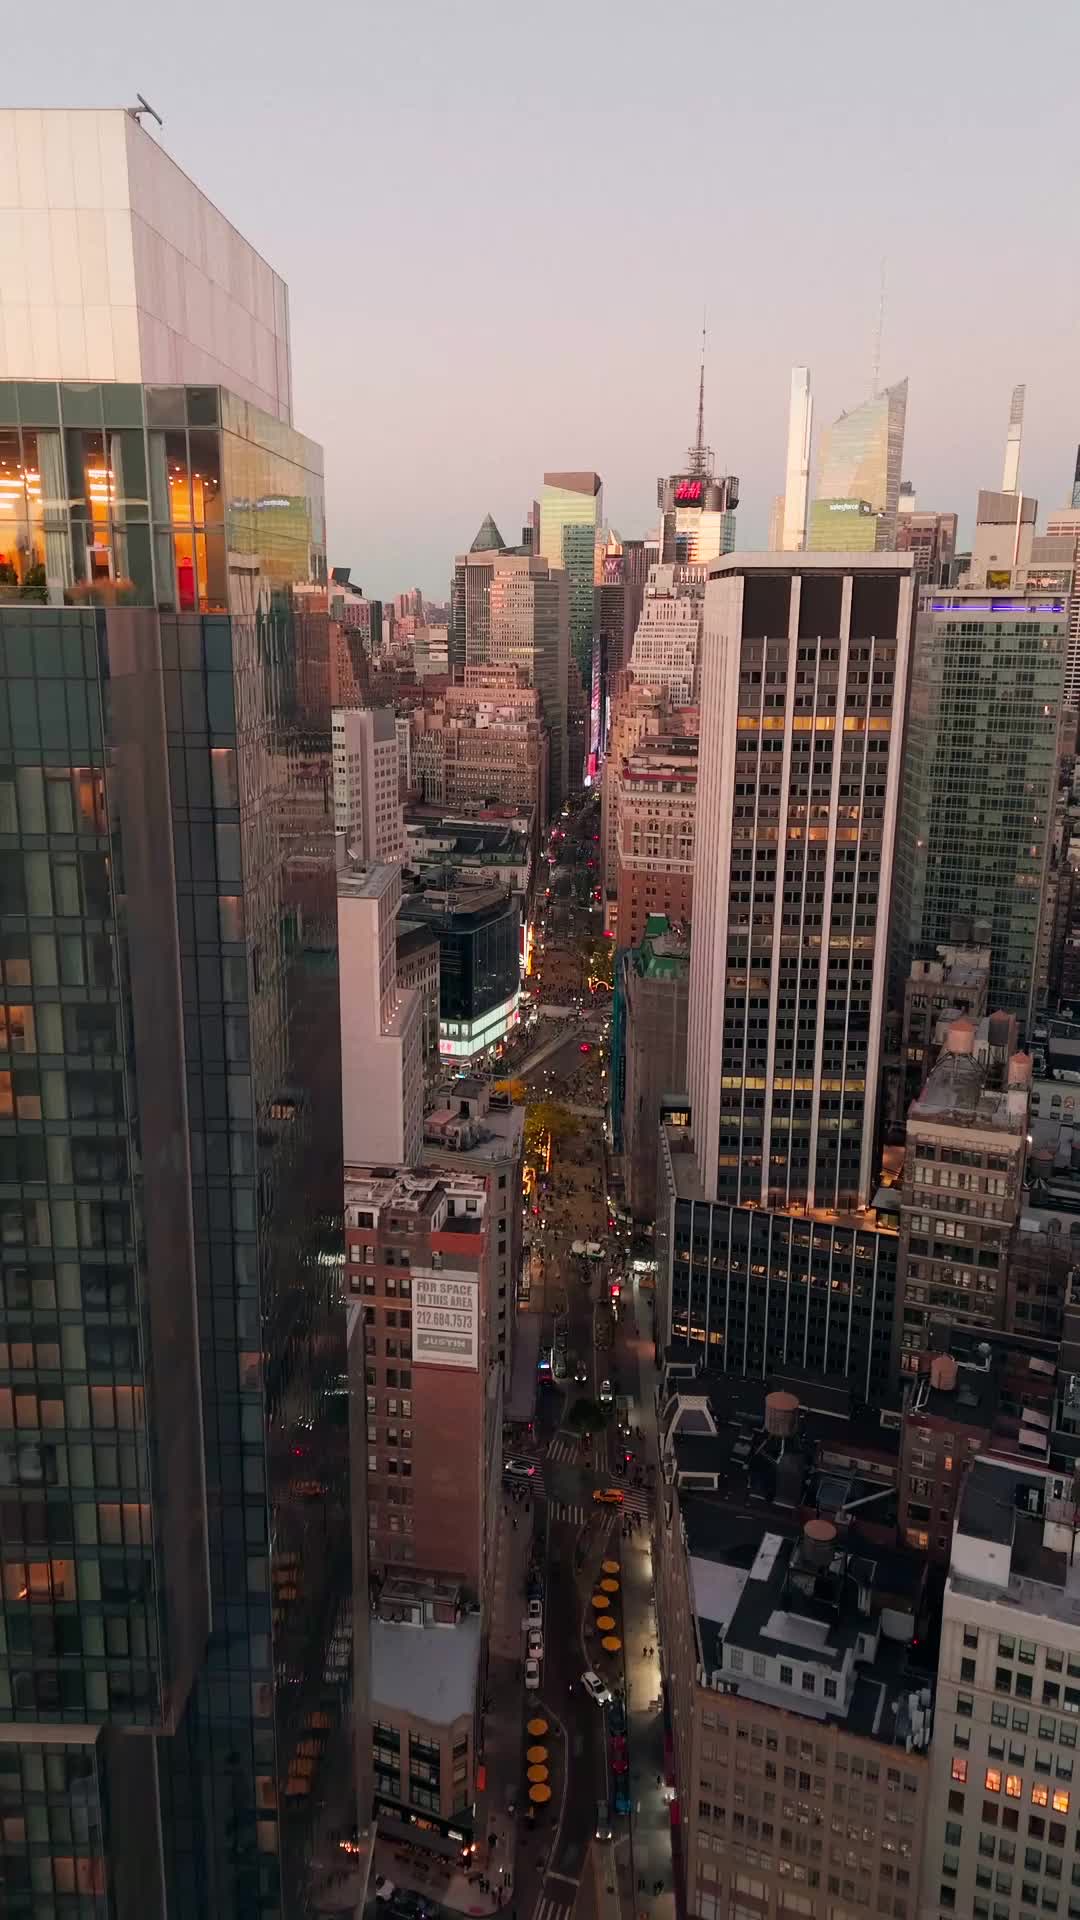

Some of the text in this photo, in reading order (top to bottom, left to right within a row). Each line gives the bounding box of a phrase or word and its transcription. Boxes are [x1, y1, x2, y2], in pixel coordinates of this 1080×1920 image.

[829, 503, 859, 512] salesforce
[605, 561, 617, 570] W
[417, 1281, 472, 1295] FOR SPACE
[417, 1293, 472, 1308] IN THIS AREA
[423, 1337, 466, 1348] JUSTIN
